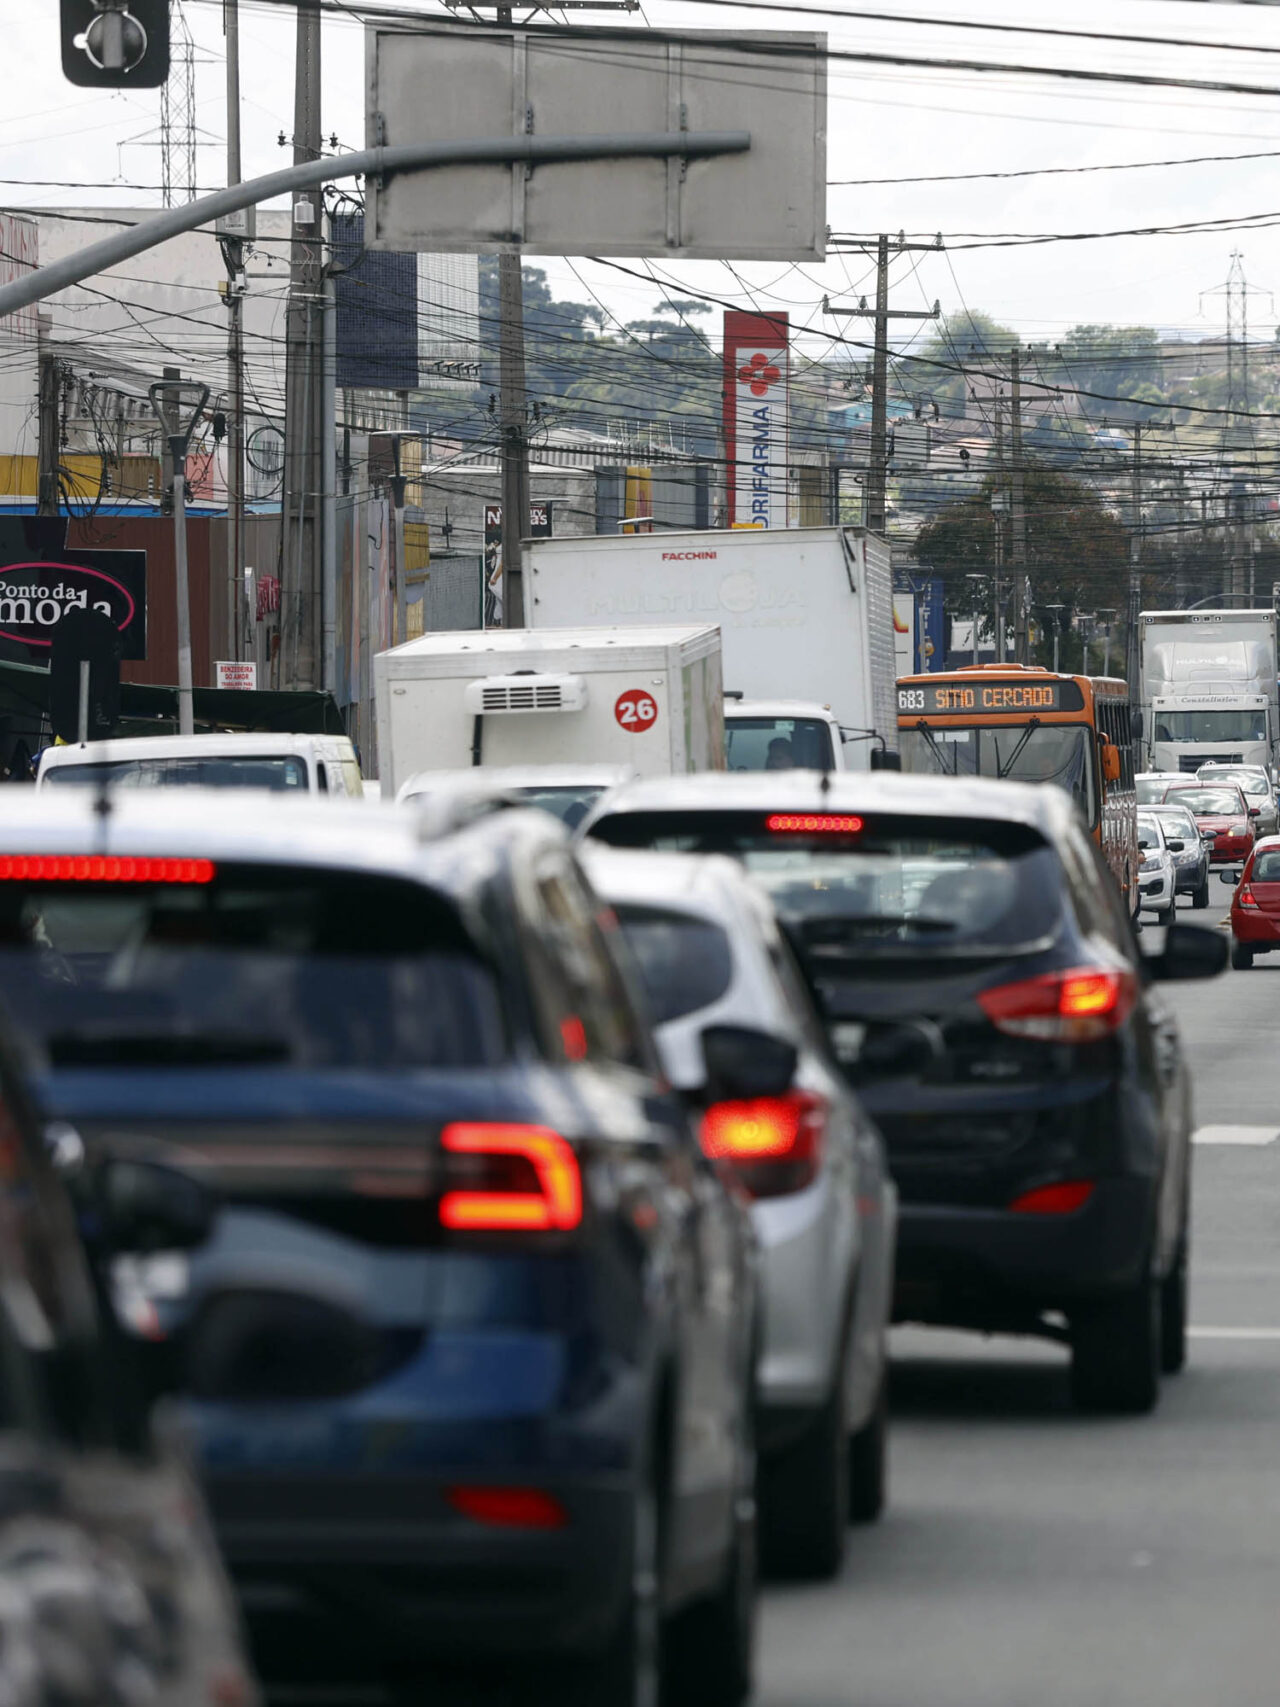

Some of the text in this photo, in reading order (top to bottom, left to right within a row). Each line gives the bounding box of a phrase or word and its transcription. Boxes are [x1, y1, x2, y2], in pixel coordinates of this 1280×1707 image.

[662, 551, 717, 561] FACCHINI
[52, 582, 77, 600] da
[898, 686, 1054, 709] 683 SITIO CERCADO
[619, 698, 655, 724] 26
